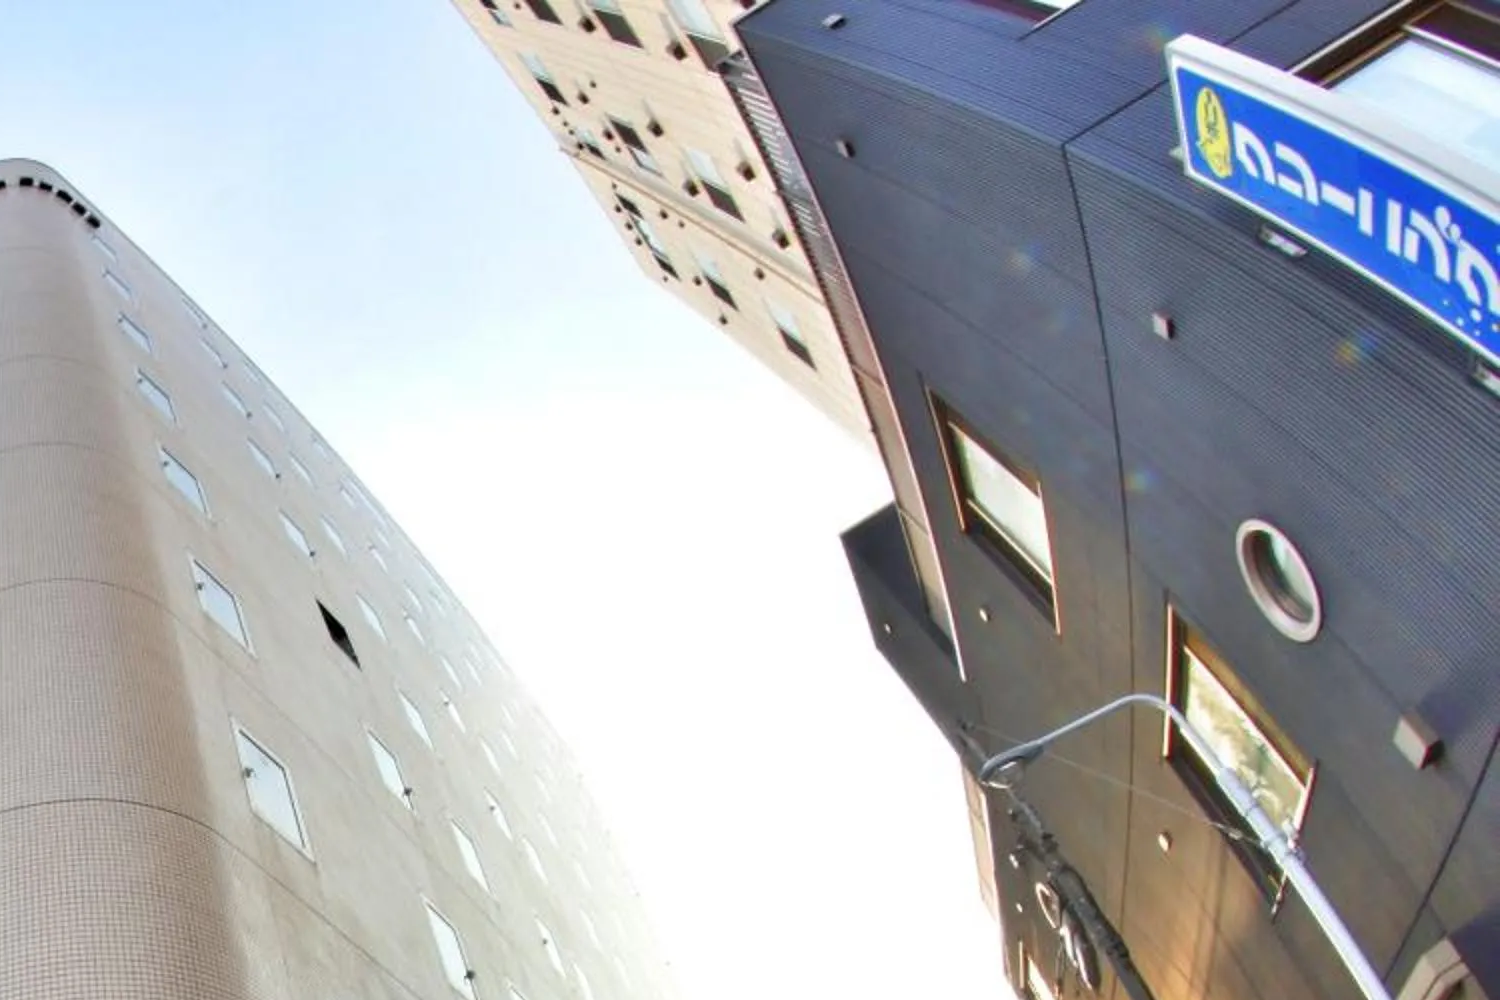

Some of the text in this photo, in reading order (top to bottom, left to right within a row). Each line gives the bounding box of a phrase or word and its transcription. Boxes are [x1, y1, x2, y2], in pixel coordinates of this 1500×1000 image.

[1232, 120, 1500, 318] クリーニング
